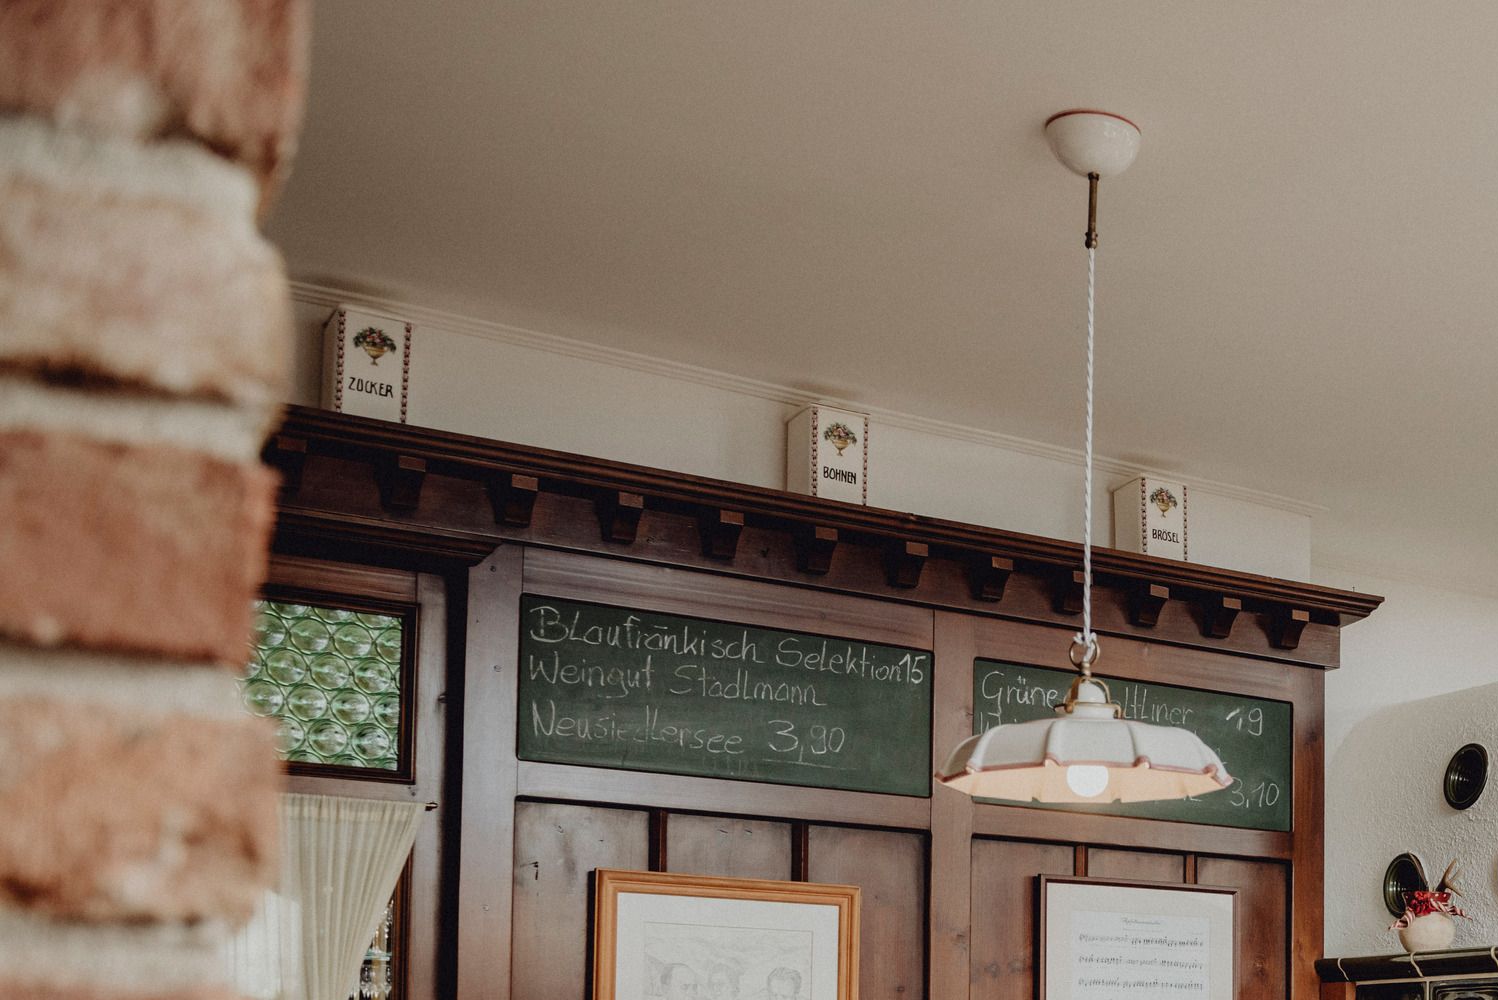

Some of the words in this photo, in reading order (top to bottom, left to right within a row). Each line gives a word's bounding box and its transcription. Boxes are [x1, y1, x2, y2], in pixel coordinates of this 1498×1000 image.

[348, 376, 394, 399] ZUCKER
[823, 465, 857, 485] BOHNEN
[1152, 528, 1180, 544] BRÖSEL
[529, 650, 655, 699] Weingut
[669, 664, 828, 706] Stadlmann
[899, 653, 926, 684] 15
[981, 671, 1060, 728] Grüne
[768, 719, 845, 763] 3,90
[1229, 776, 1280, 810] 3,10
